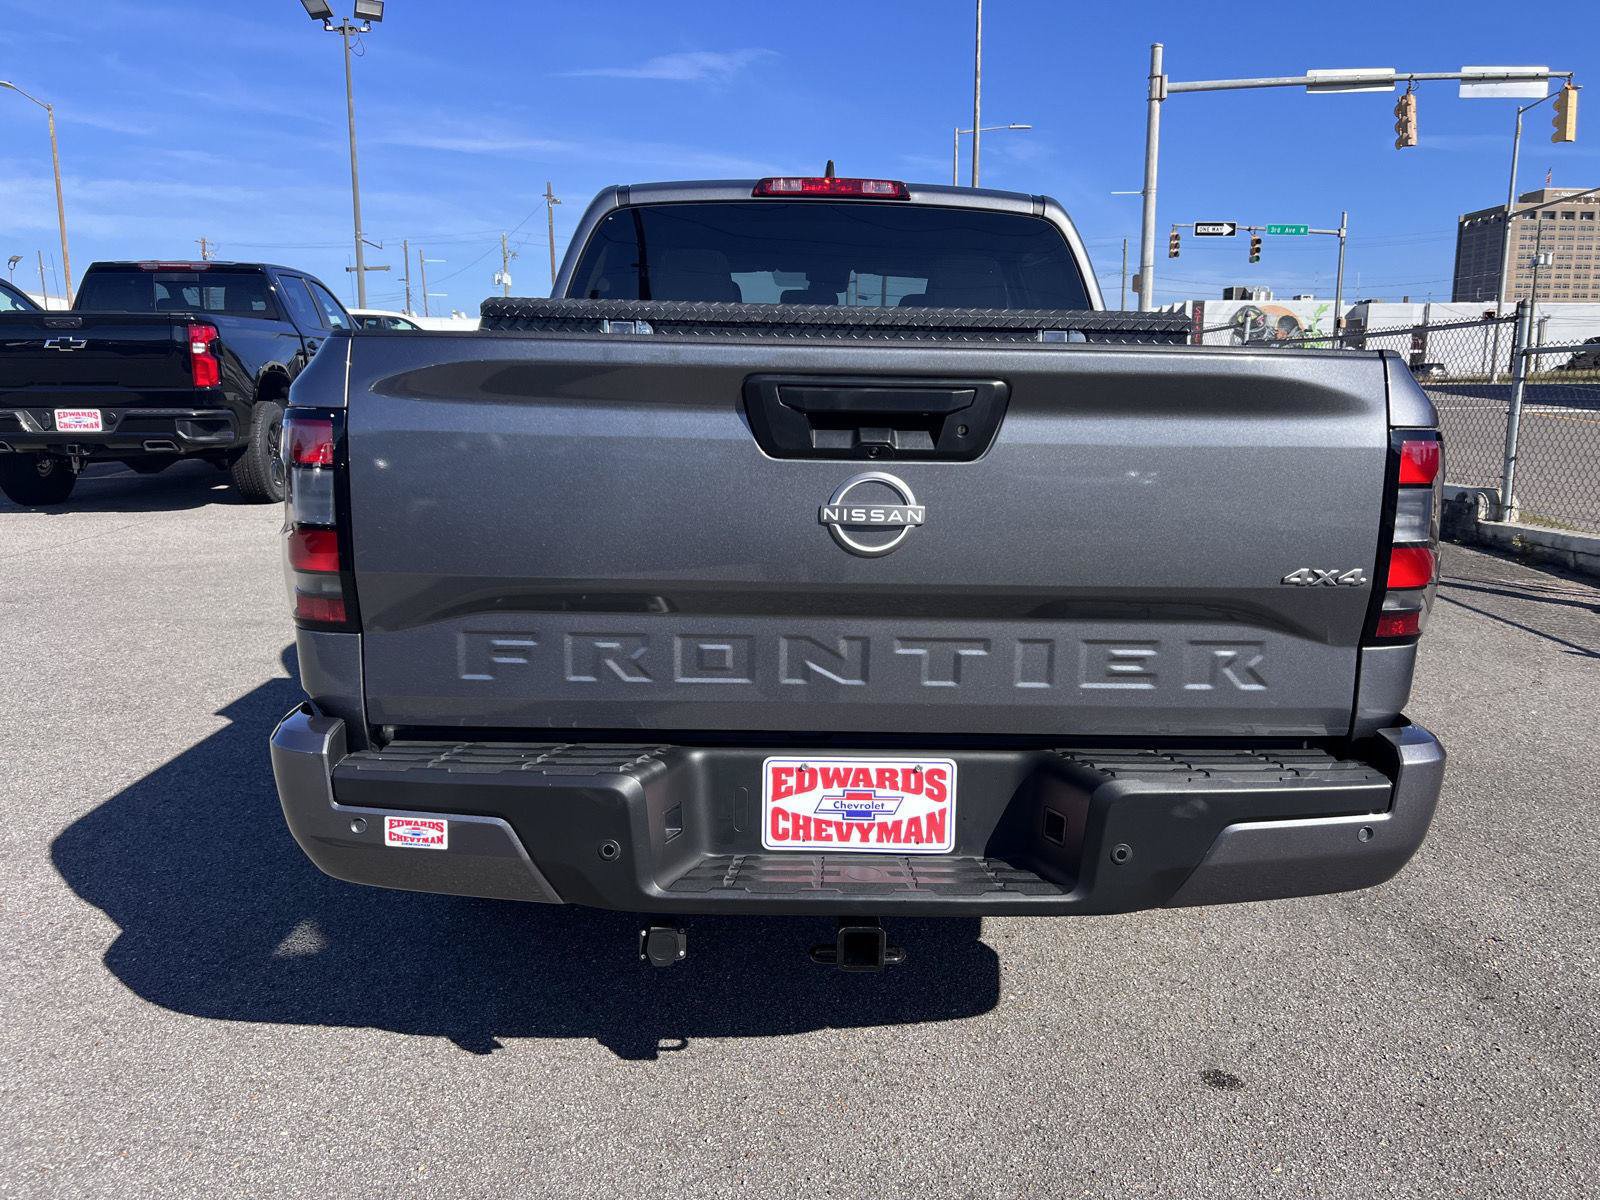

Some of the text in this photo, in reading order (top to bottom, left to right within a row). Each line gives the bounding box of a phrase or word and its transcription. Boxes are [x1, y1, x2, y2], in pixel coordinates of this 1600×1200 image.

[57, 411, 99, 420] EDWARDS
[58, 421, 100, 429] CHEVYMAN
[823, 507, 922, 523] NISSAN
[456, 630, 1268, 690] FRONTIER
[771, 766, 948, 803] EDWARDS
[833, 800, 885, 810] Chevrolet
[388, 818, 445, 833] EDWARDS
[770, 806, 948, 844] CHEVYMAN
[388, 831, 445, 845] CHEVYMAN
